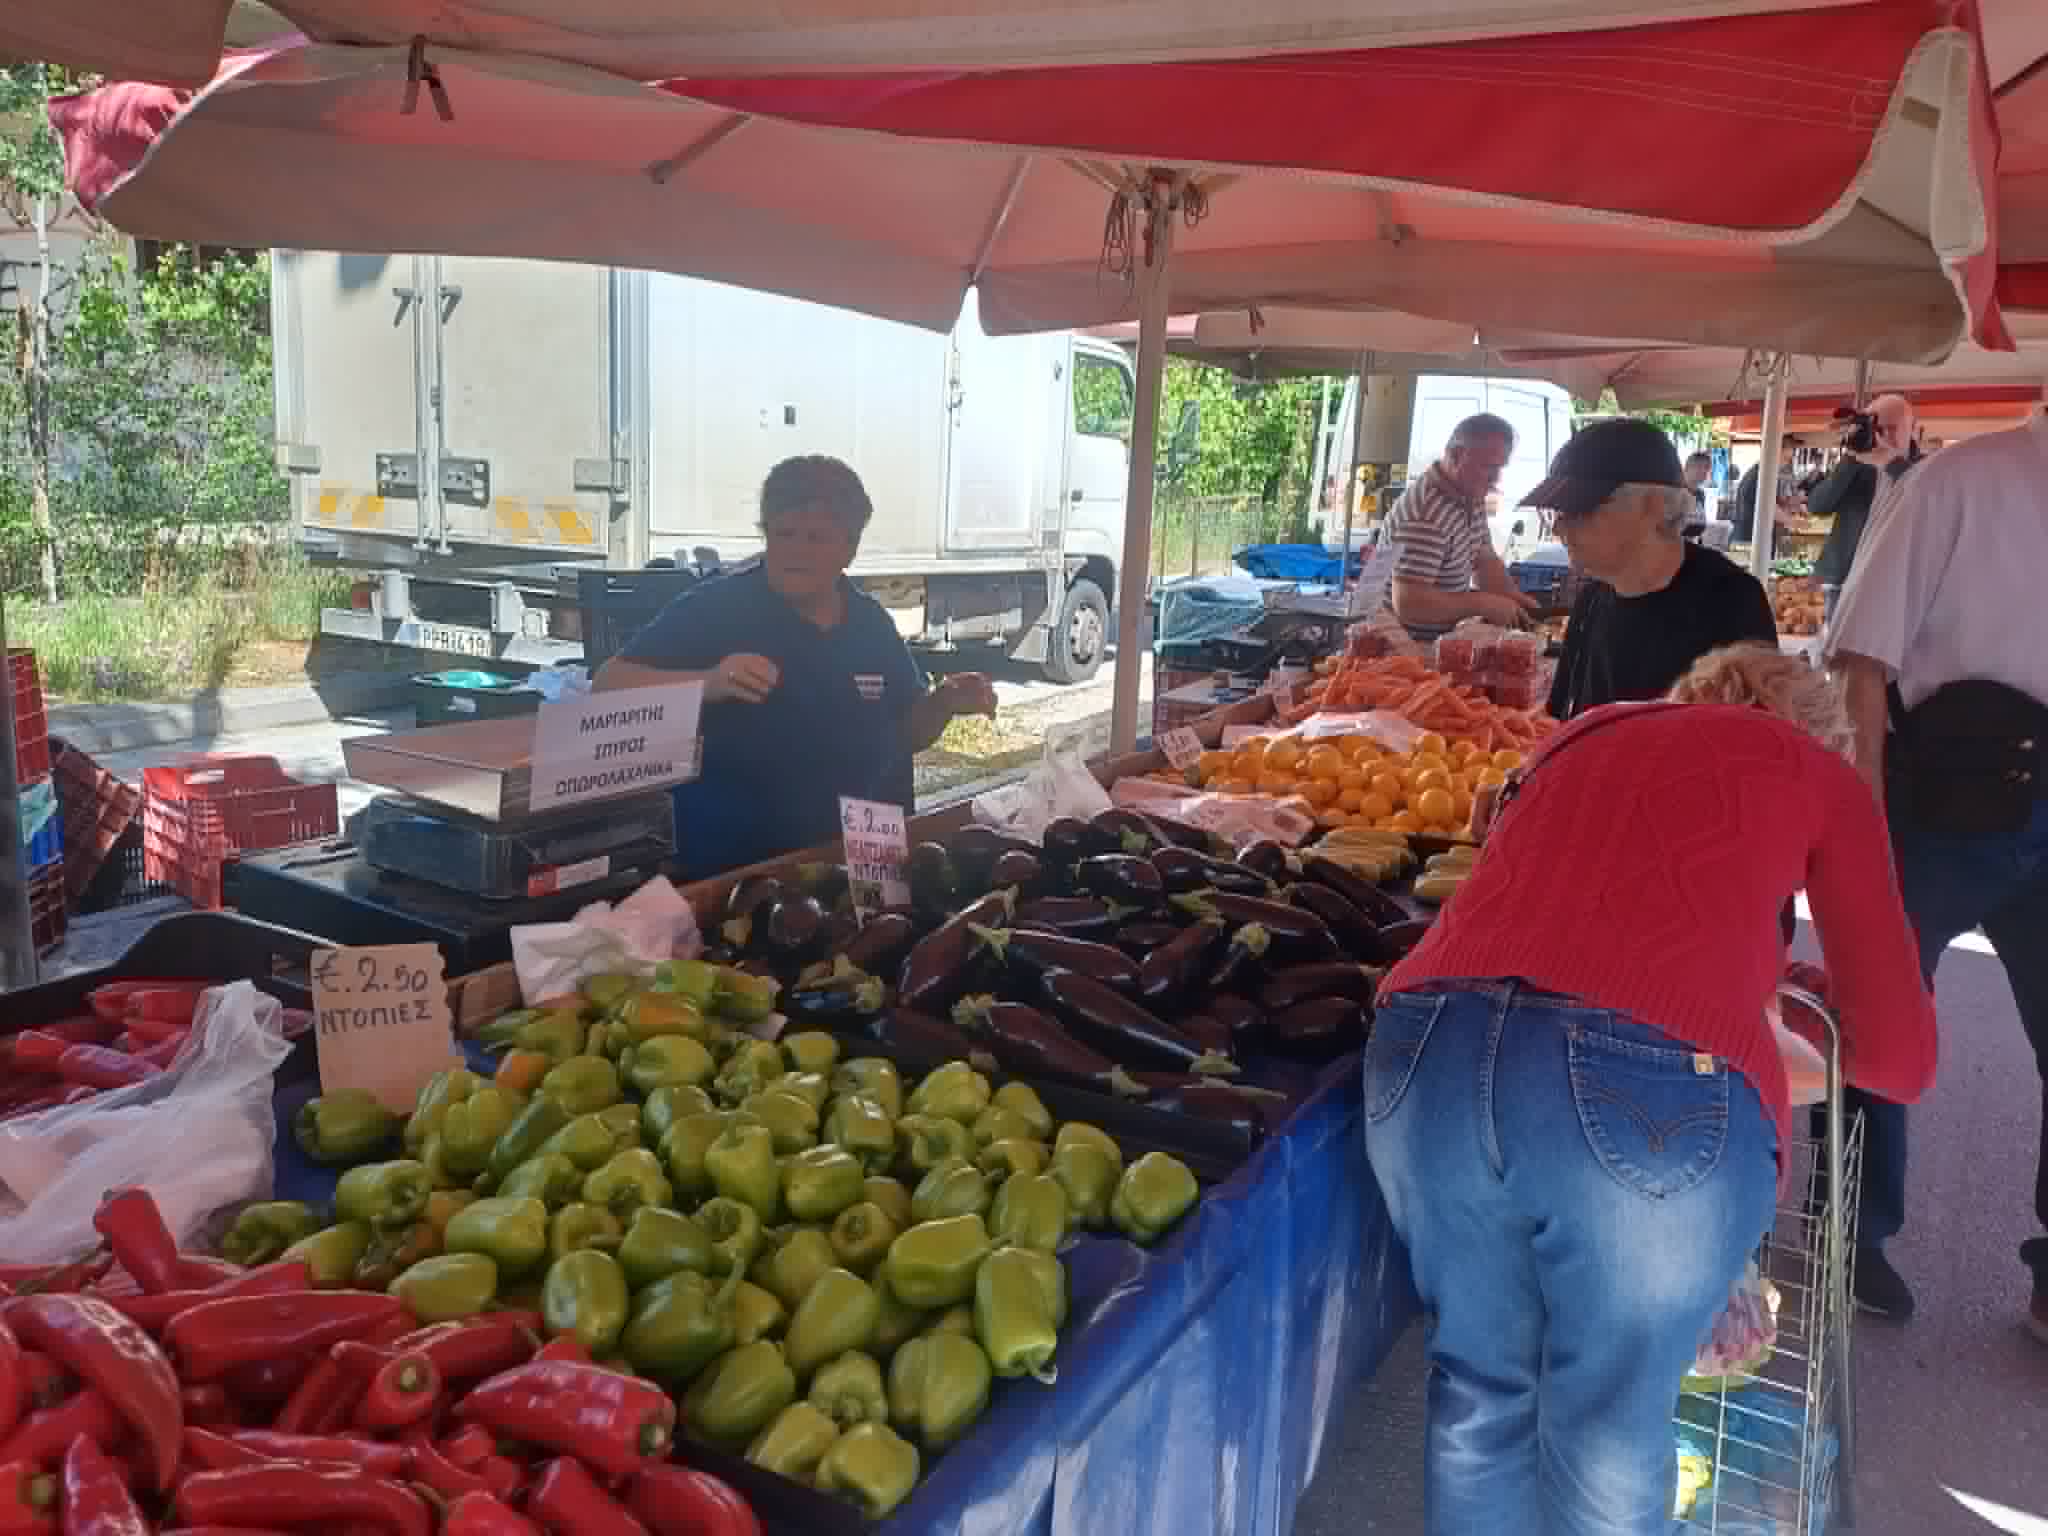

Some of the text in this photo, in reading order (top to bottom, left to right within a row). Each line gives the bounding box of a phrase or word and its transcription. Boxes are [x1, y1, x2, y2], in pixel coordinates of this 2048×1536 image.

[579, 703, 664, 734] ΜΑΡΓΑΡΙΤΗΣ
[594, 735, 646, 760] ΣΠΥΡΟΣ
[555, 760, 673, 797] ΟΠΩΡΟΛΑΧΑΝΙΚΑ
[320, 998, 433, 1034] ΝΤΟΠΙΕΣ
